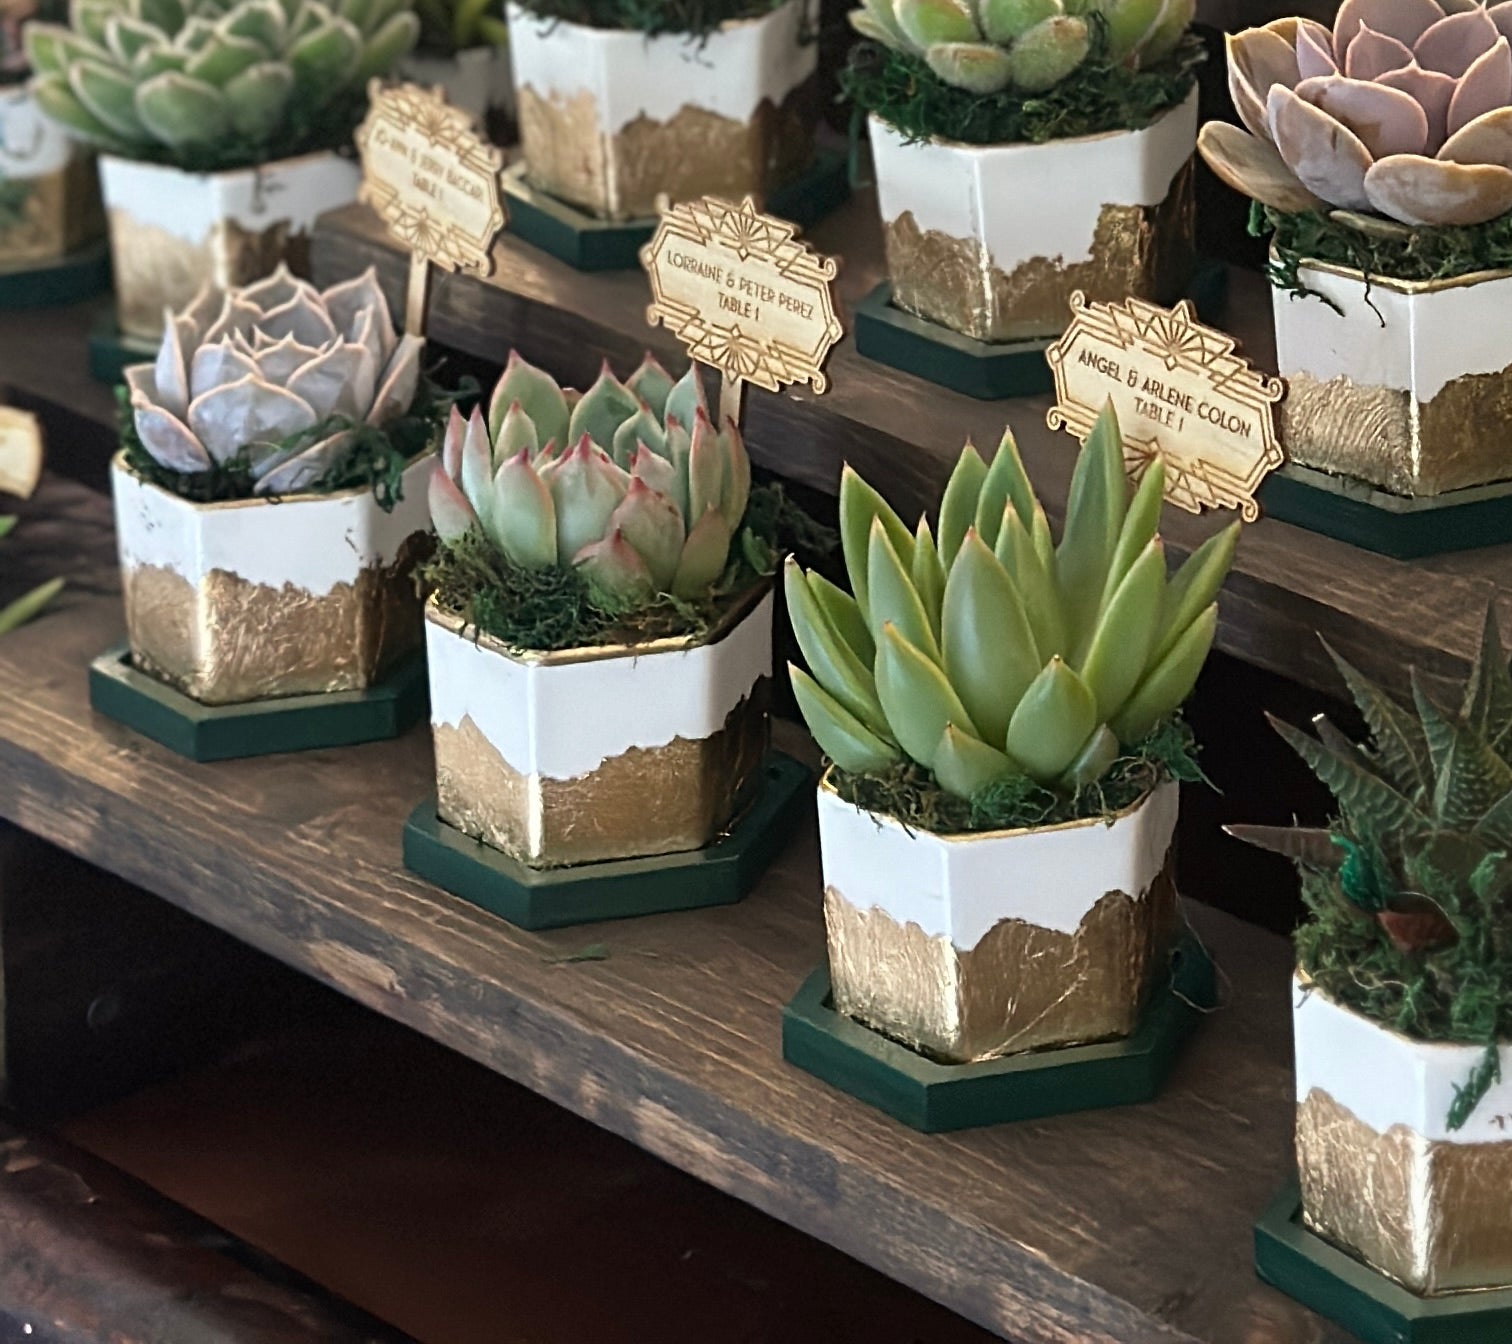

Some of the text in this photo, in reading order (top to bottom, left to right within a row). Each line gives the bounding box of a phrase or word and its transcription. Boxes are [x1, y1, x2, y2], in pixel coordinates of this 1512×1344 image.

[667, 249, 724, 284] LORRAINE
[738, 276, 776, 304] PETER
[778, 291, 815, 321] PEREZ
[718, 291, 760, 322] TABLE 1
[1078, 349, 1252, 439] ANGEL & ARLENE COLON
[1134, 396, 1184, 433] TABLE 1
